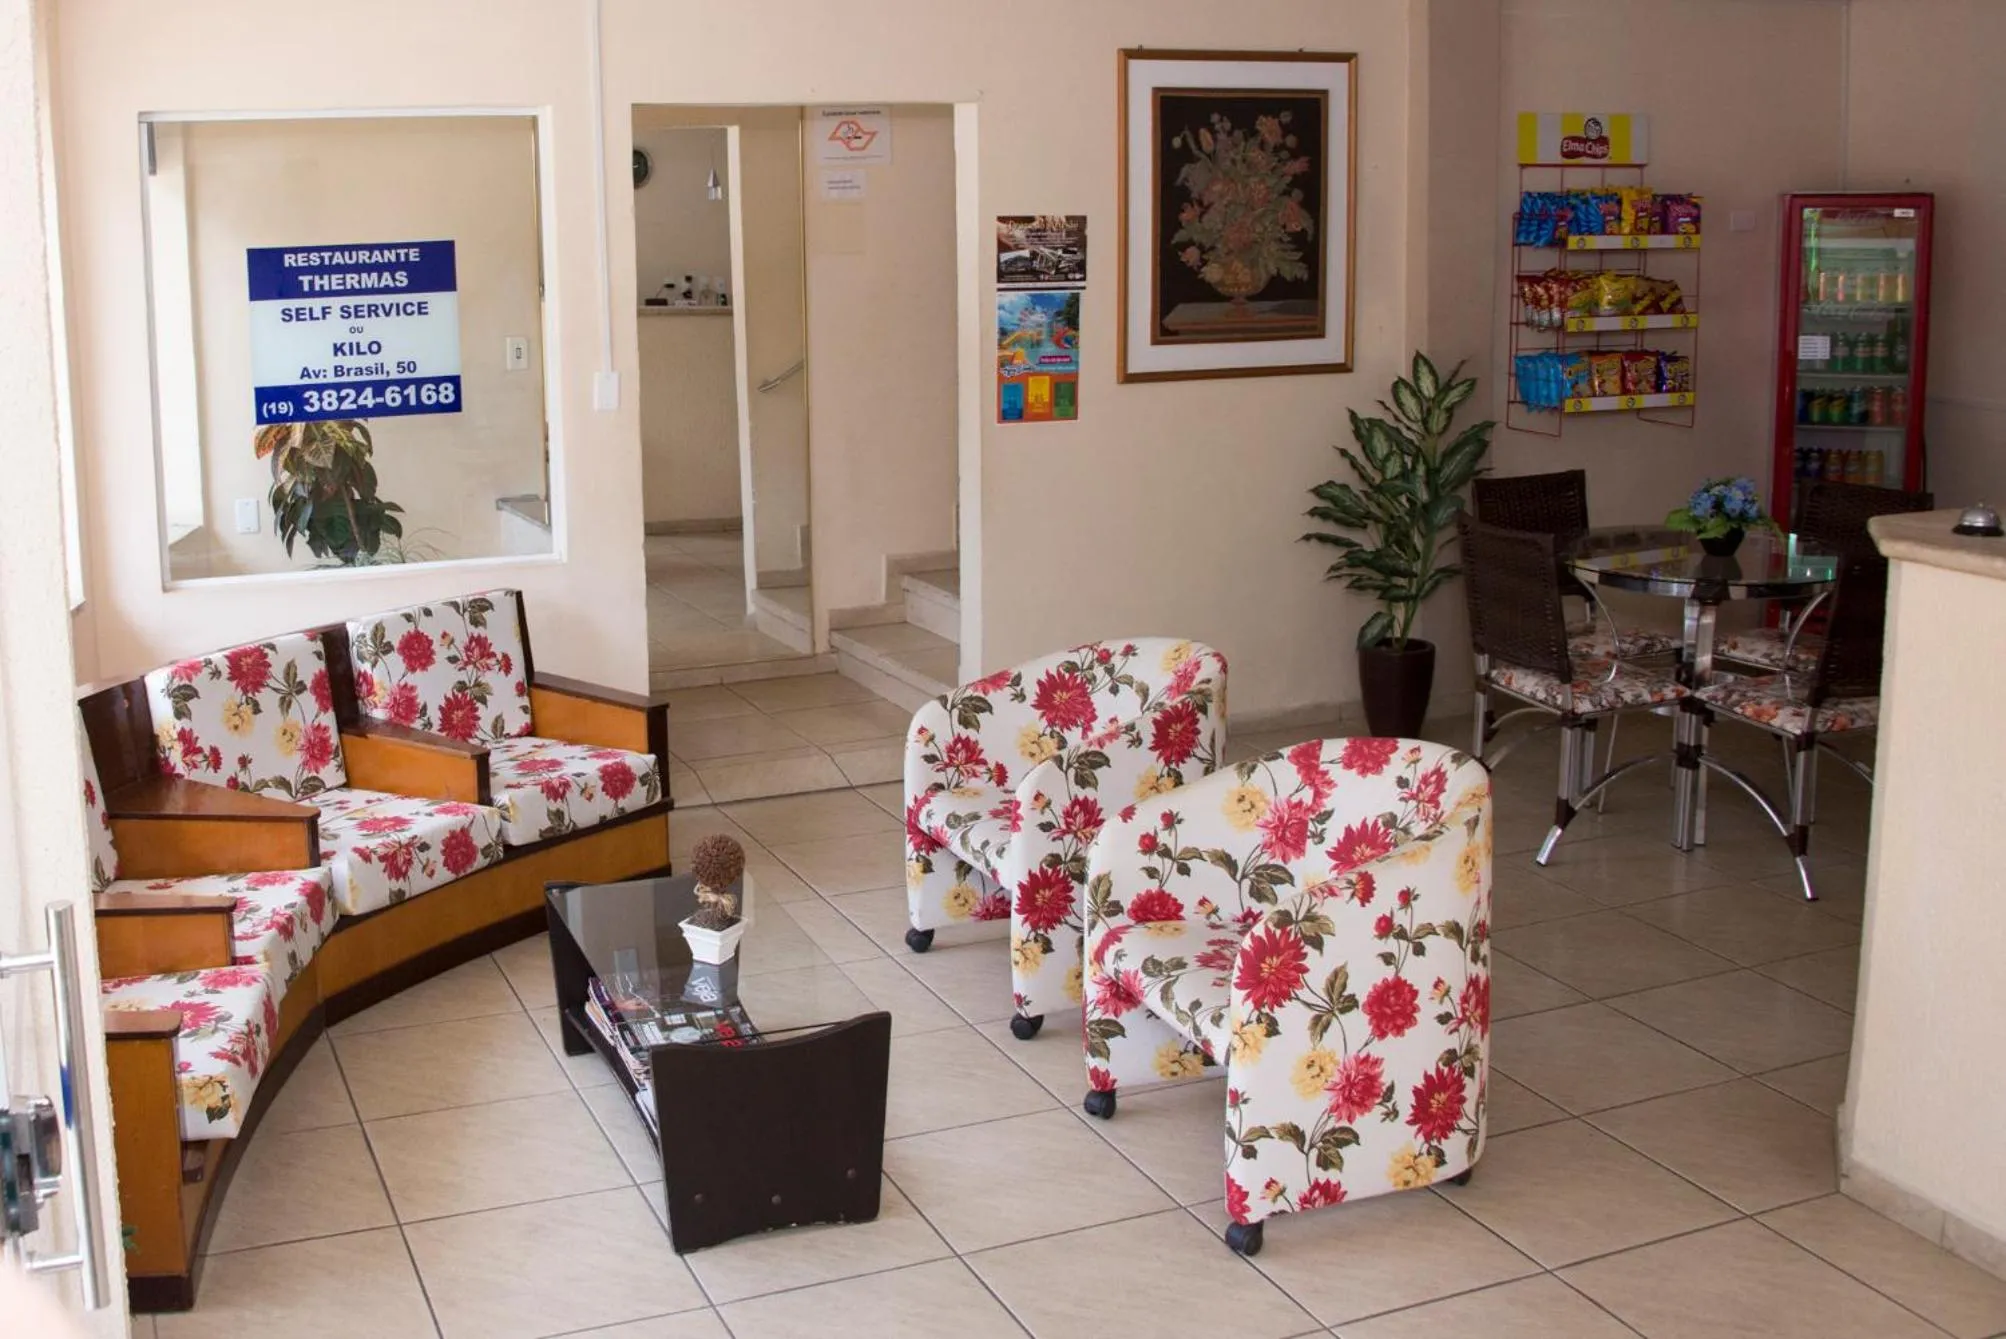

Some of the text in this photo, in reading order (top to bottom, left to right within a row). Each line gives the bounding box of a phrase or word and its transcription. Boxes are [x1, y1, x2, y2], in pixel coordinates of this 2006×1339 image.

[283, 248, 421, 268] RESTAURANTE
[298, 271, 409, 292] THERMAS
[280, 301, 430, 323] SELF SERVICE
[332, 340, 383, 357] KILO
[333, 362, 391, 378] Brasil,
[396, 360, 418, 374] 50
[262, 382, 456, 417] (19) 3824-6168
